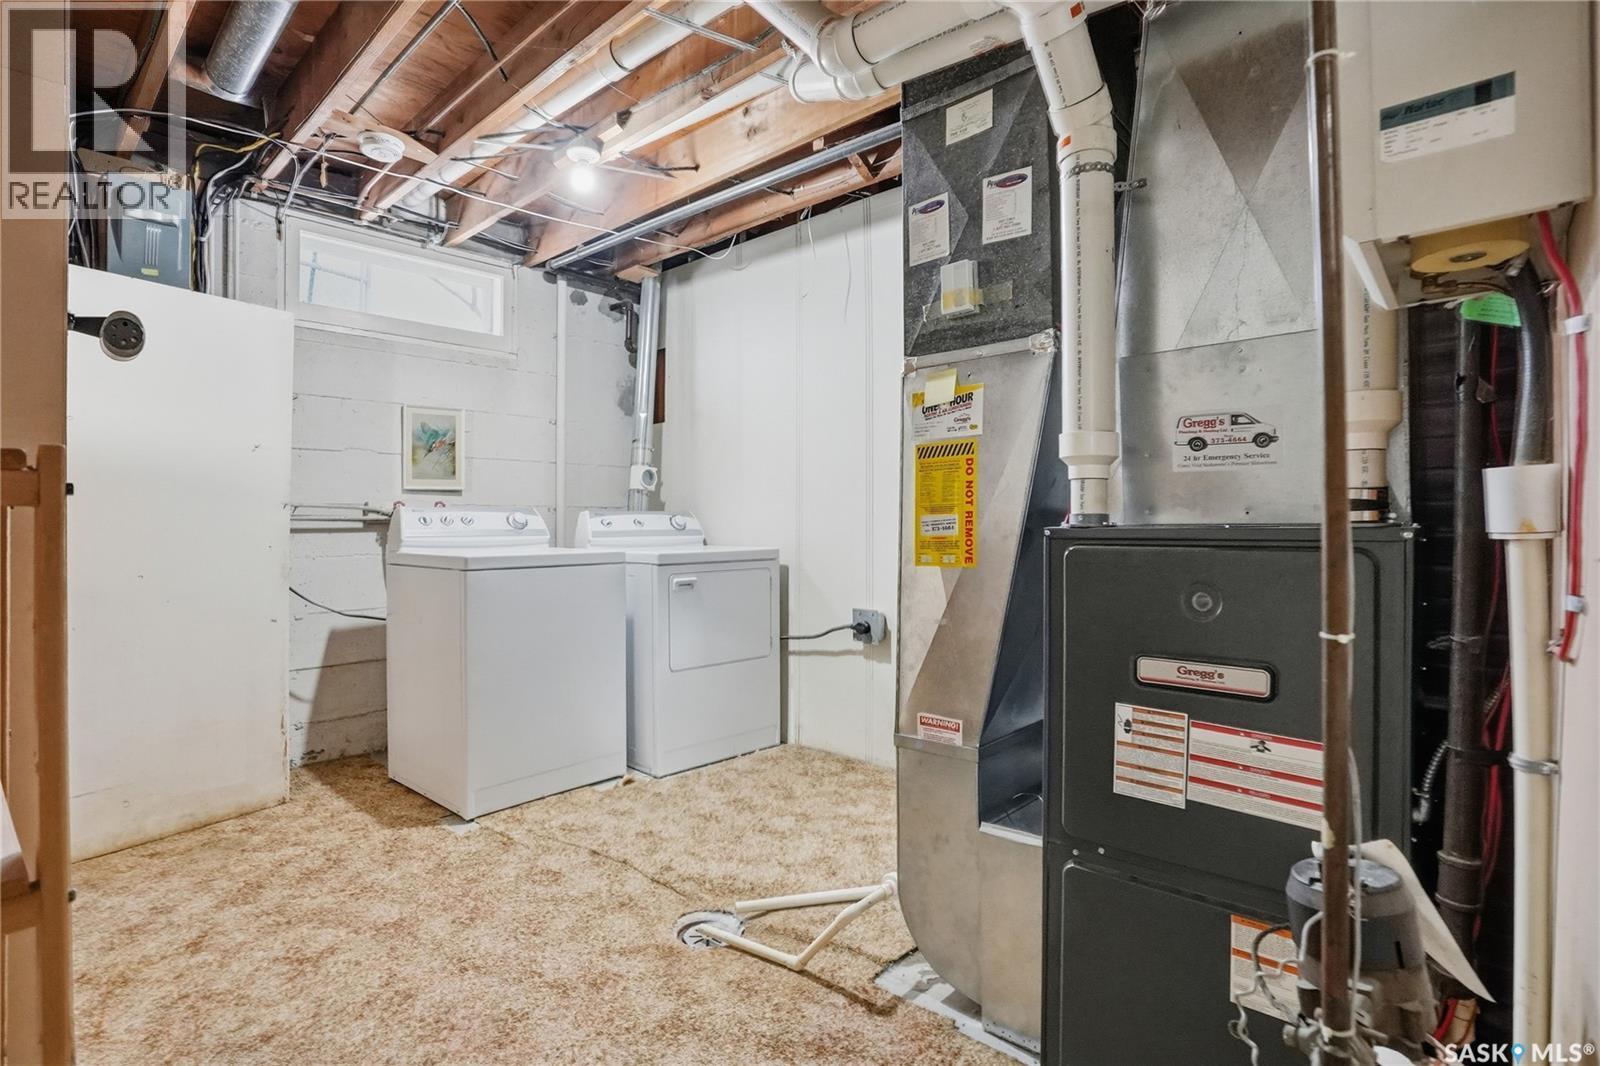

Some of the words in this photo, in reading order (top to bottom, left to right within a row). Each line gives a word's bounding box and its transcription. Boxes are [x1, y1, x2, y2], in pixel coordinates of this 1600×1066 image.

[1183, 416, 1225, 429] Gregg's
[1203, 454, 1241, 462] Emergency
[1243, 452, 1271, 460] Service
[964, 457, 974, 476] DO
[964, 480, 974, 506] NOT
[964, 510, 974, 565] REMOVE
[1177, 665, 1225, 680] Gregg's
[920, 716, 959, 730] WARNING!
